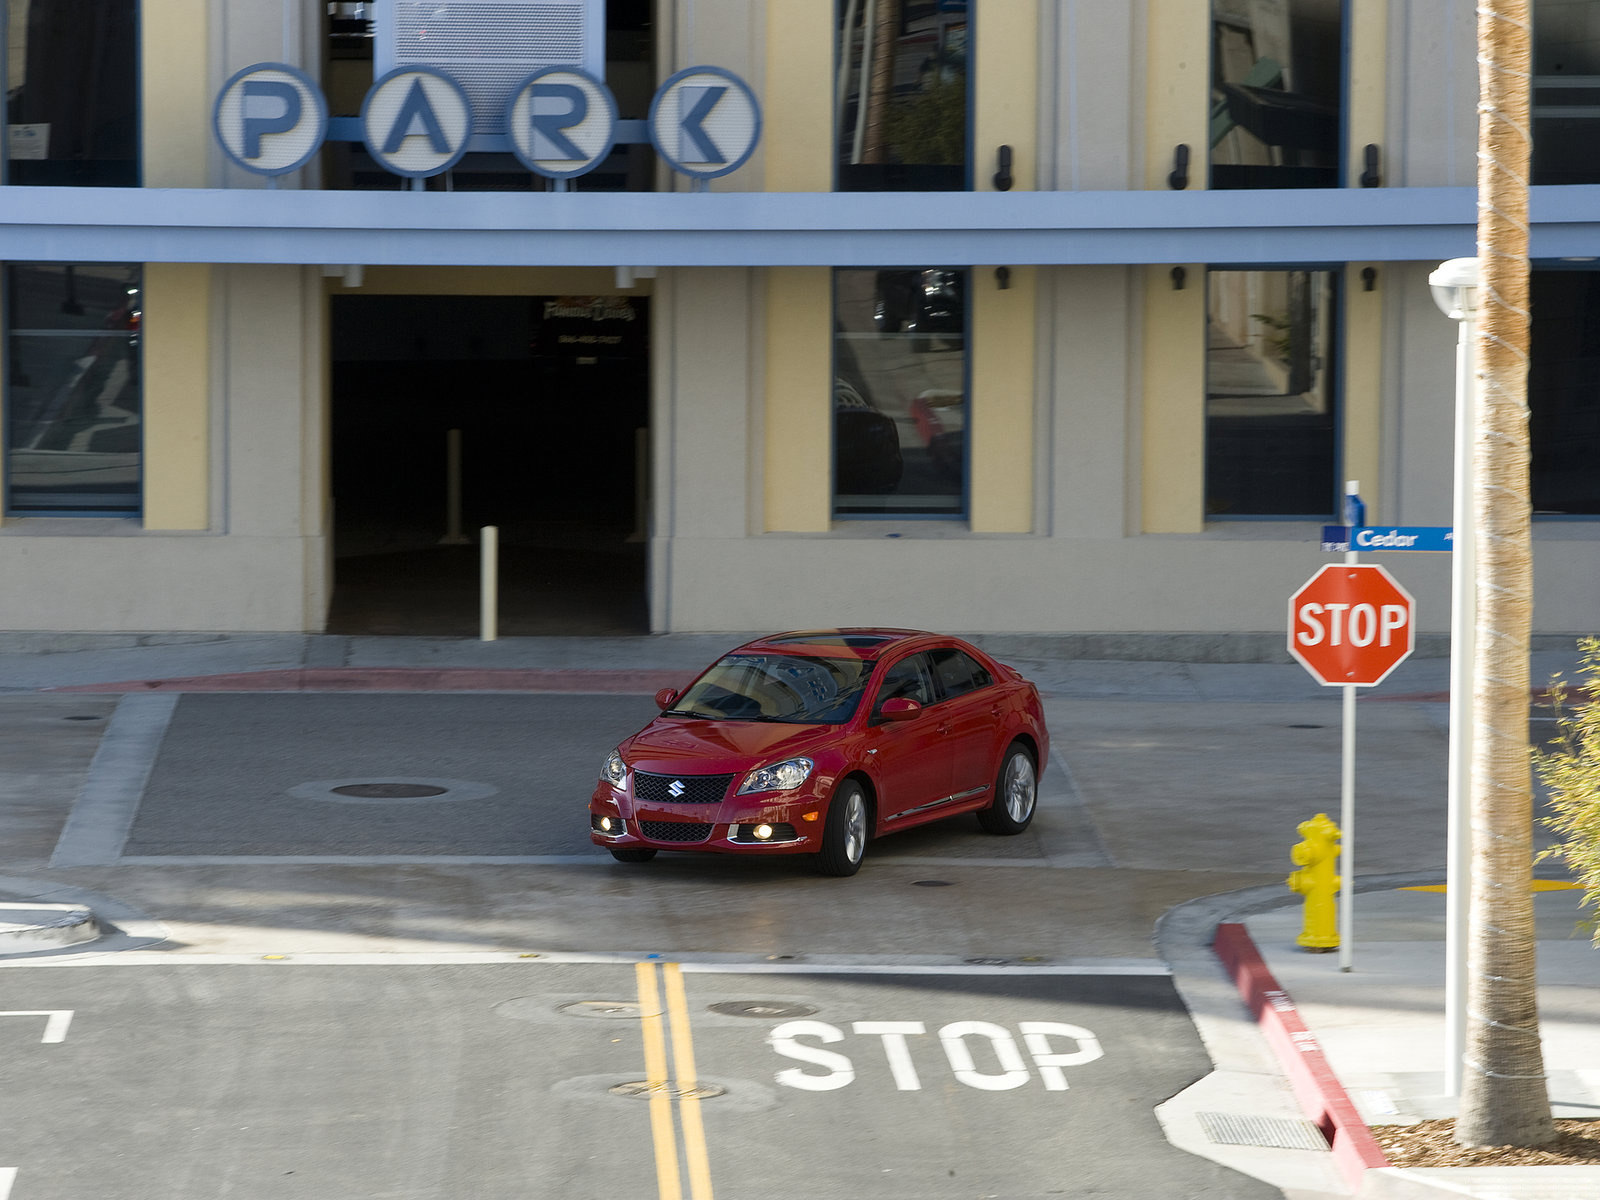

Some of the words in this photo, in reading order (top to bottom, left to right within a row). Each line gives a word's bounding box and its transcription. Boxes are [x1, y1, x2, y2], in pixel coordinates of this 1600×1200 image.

[242, 77, 729, 165] PARK
[1356, 529, 1419, 547] Cedar
[1297, 602, 1408, 648] STOP
[768, 1021, 1104, 1091] STOP
